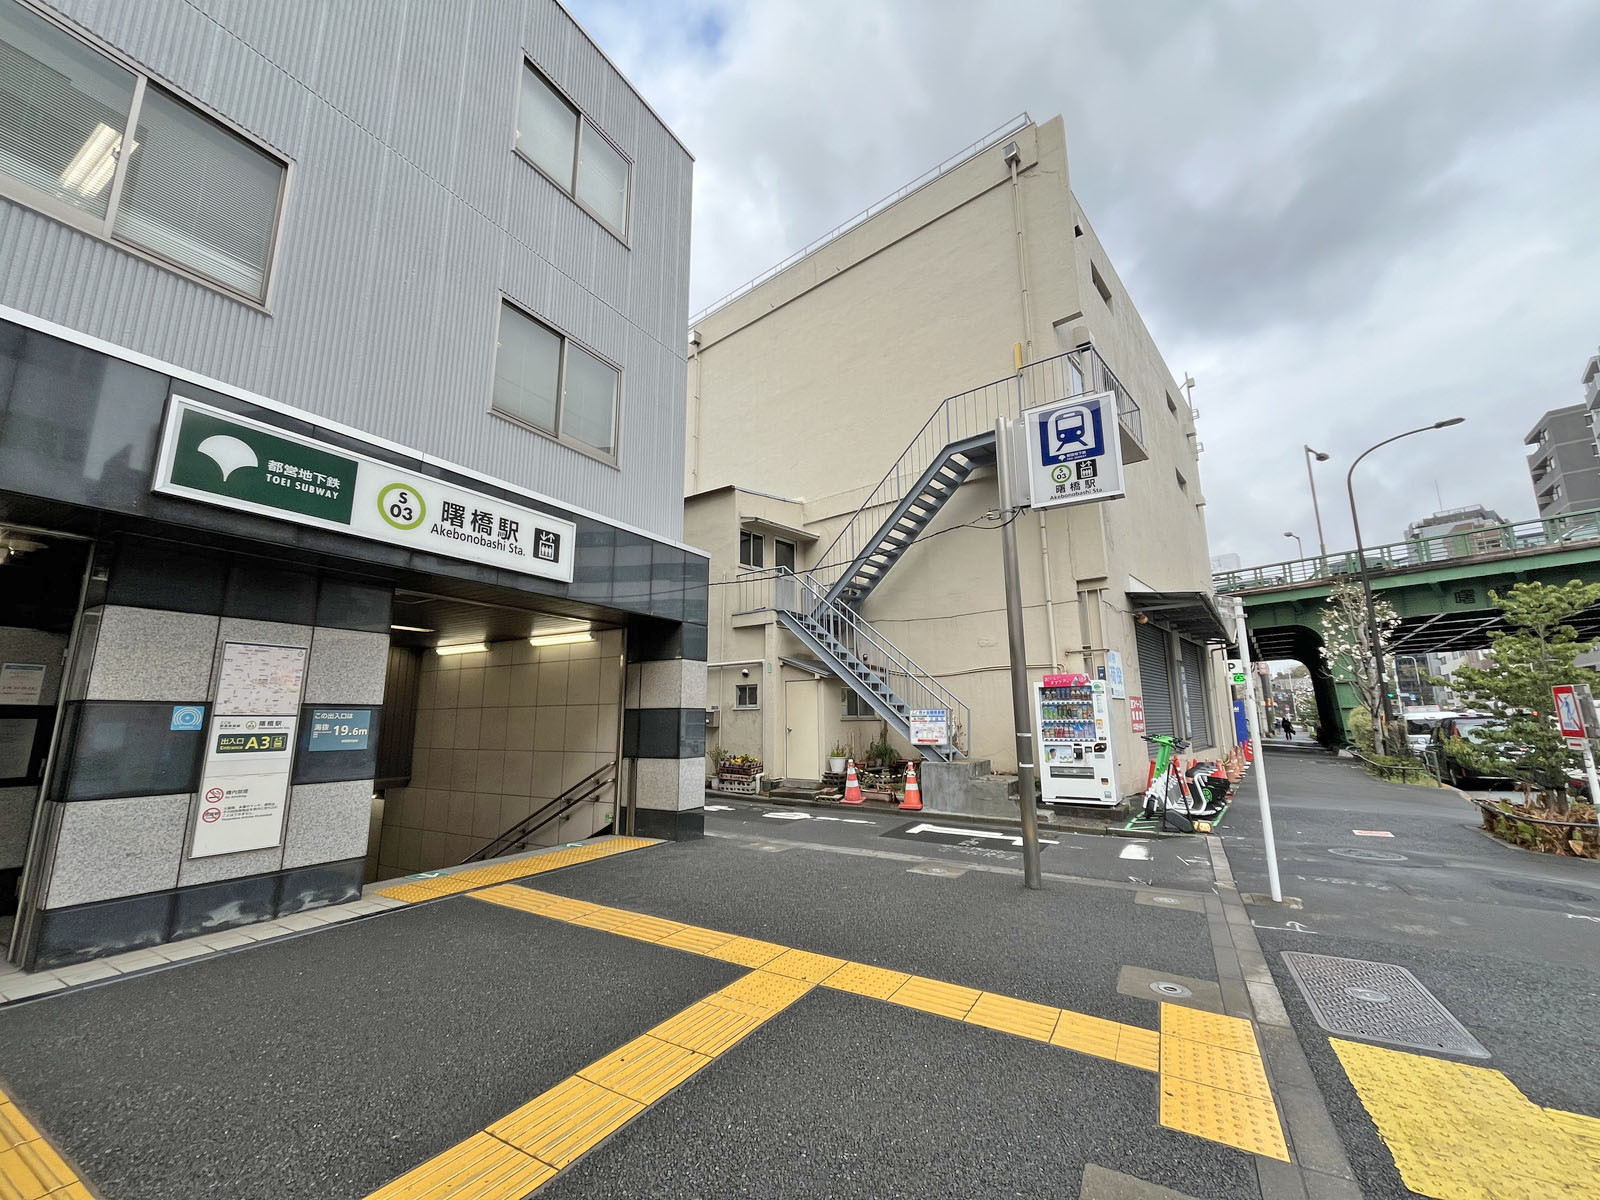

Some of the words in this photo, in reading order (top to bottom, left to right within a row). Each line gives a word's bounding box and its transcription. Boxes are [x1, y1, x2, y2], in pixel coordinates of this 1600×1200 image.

[267, 459, 341, 489] 都営地下鉄
[266, 473, 291, 488] TOEI
[295, 481, 339, 500] SUBWAY
[399, 492, 408, 504] S
[390, 504, 413, 521] 03
[441, 501, 519, 543] 曙橋駅
[430, 523, 506, 551] Akebonobashi
[508, 543, 526, 556] Sta.
[1228, 663, 1236, 672] P
[333, 725, 368, 736] 19.6m
[220, 737, 245, 745] 出入口
[244, 736, 271, 750] A3
